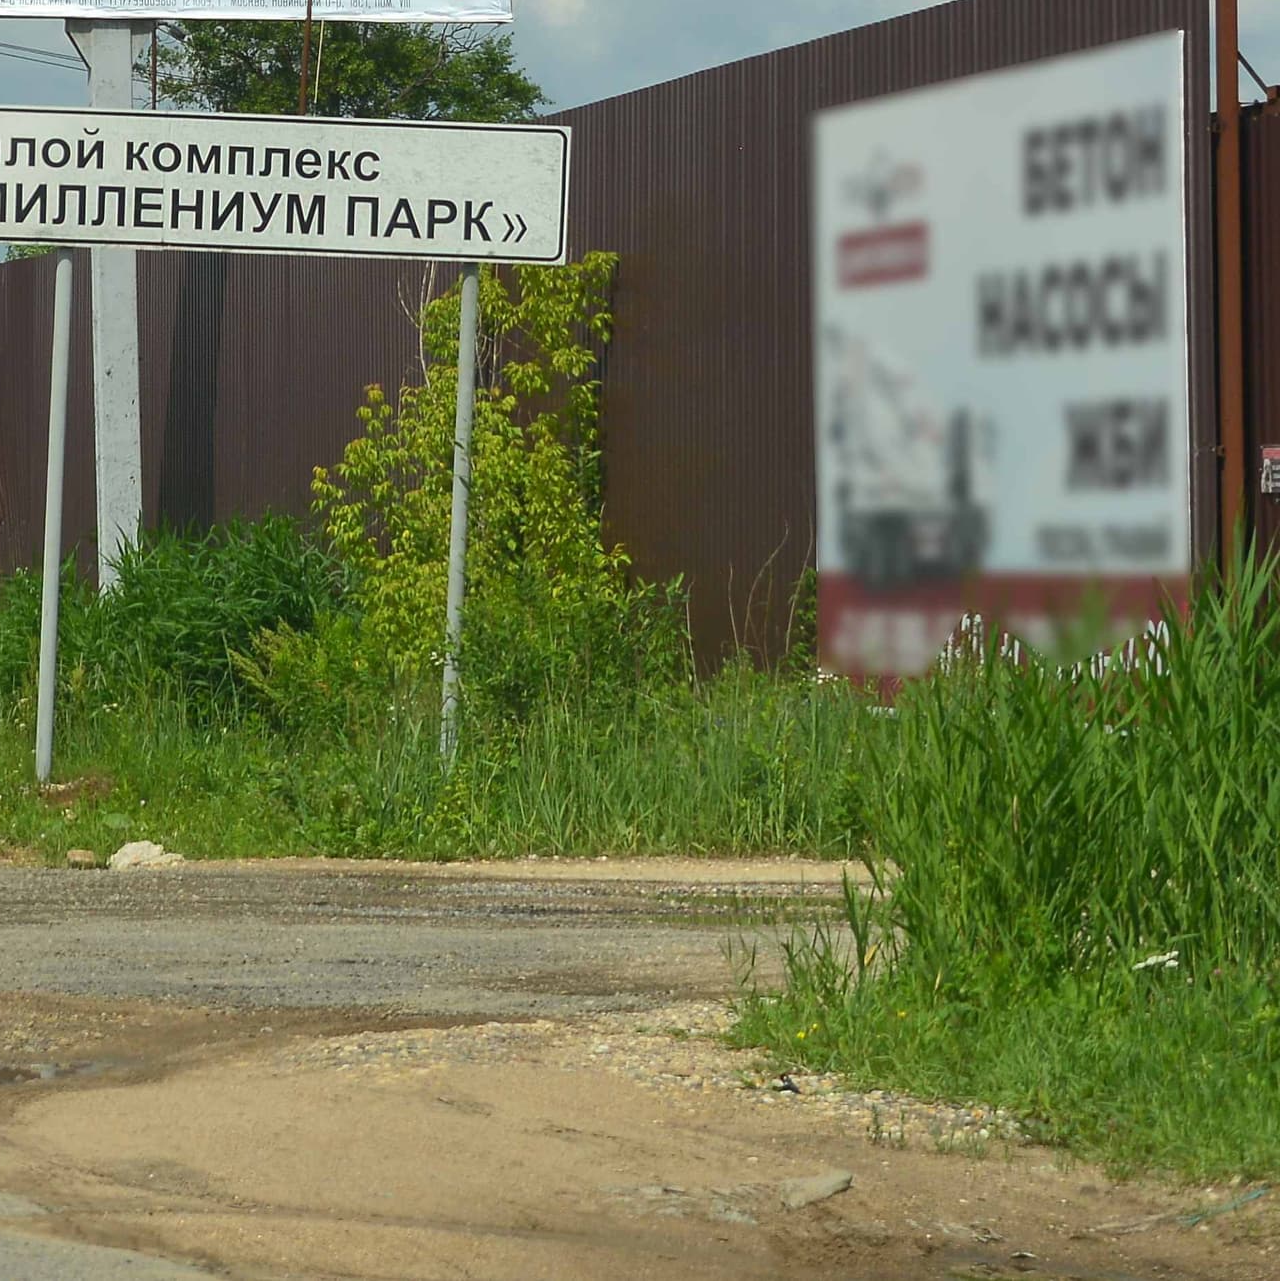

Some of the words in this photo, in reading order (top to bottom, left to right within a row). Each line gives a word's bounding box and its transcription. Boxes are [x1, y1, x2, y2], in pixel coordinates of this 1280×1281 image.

[125, 140, 381, 182] комплекс
[1021, 106, 1167, 216] БЕТОН
[345, 195, 529, 245] ПАРК»
[976, 252, 1169, 358] НАСОСЫ
